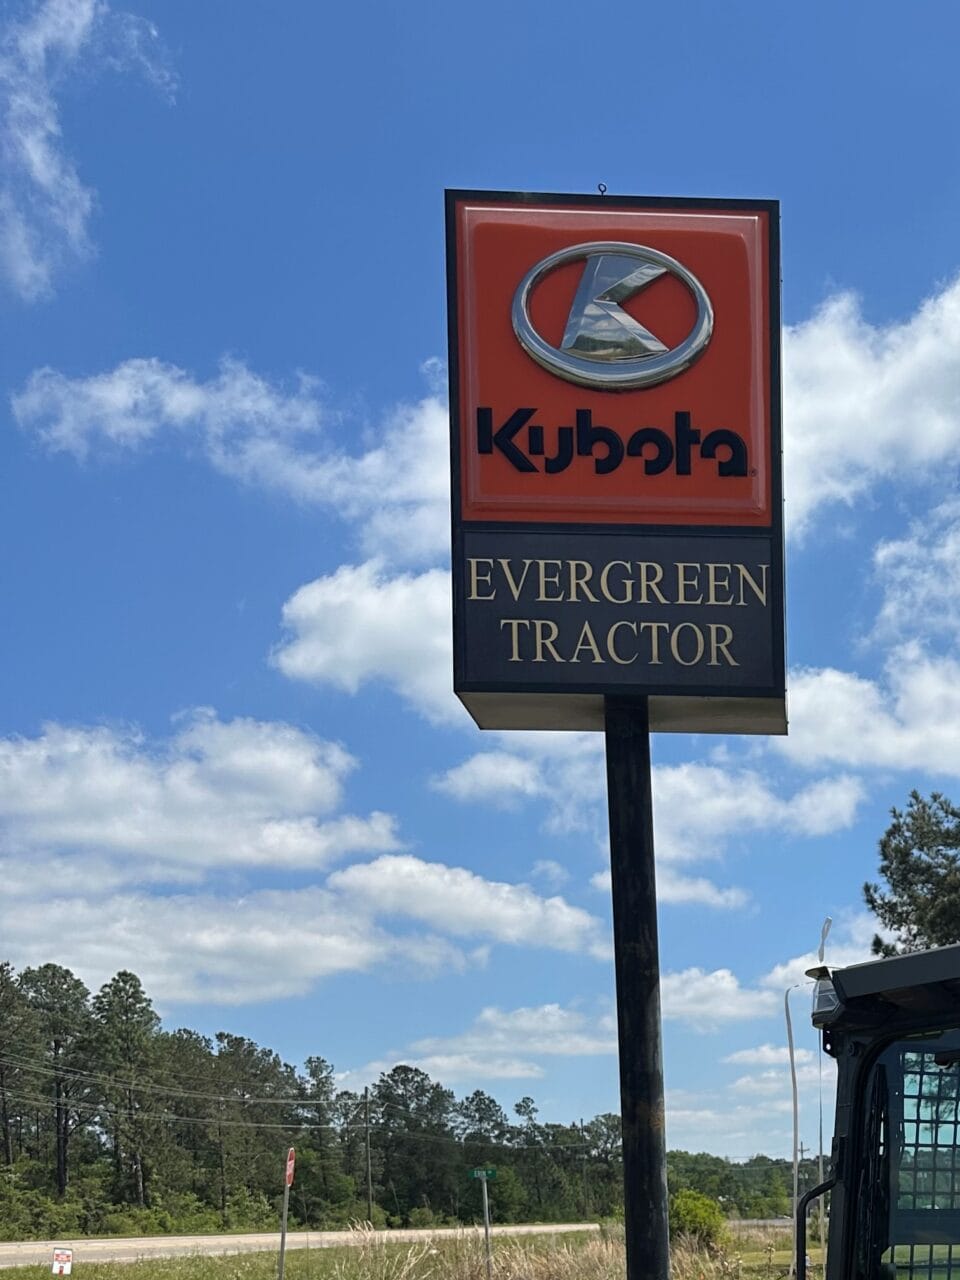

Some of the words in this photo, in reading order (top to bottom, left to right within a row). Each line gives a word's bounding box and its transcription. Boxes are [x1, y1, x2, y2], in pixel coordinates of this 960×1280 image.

[476, 406, 748, 477] Kubota
[467, 557, 770, 608] EVERGREEN
[501, 618, 740, 667] TRACTOR
